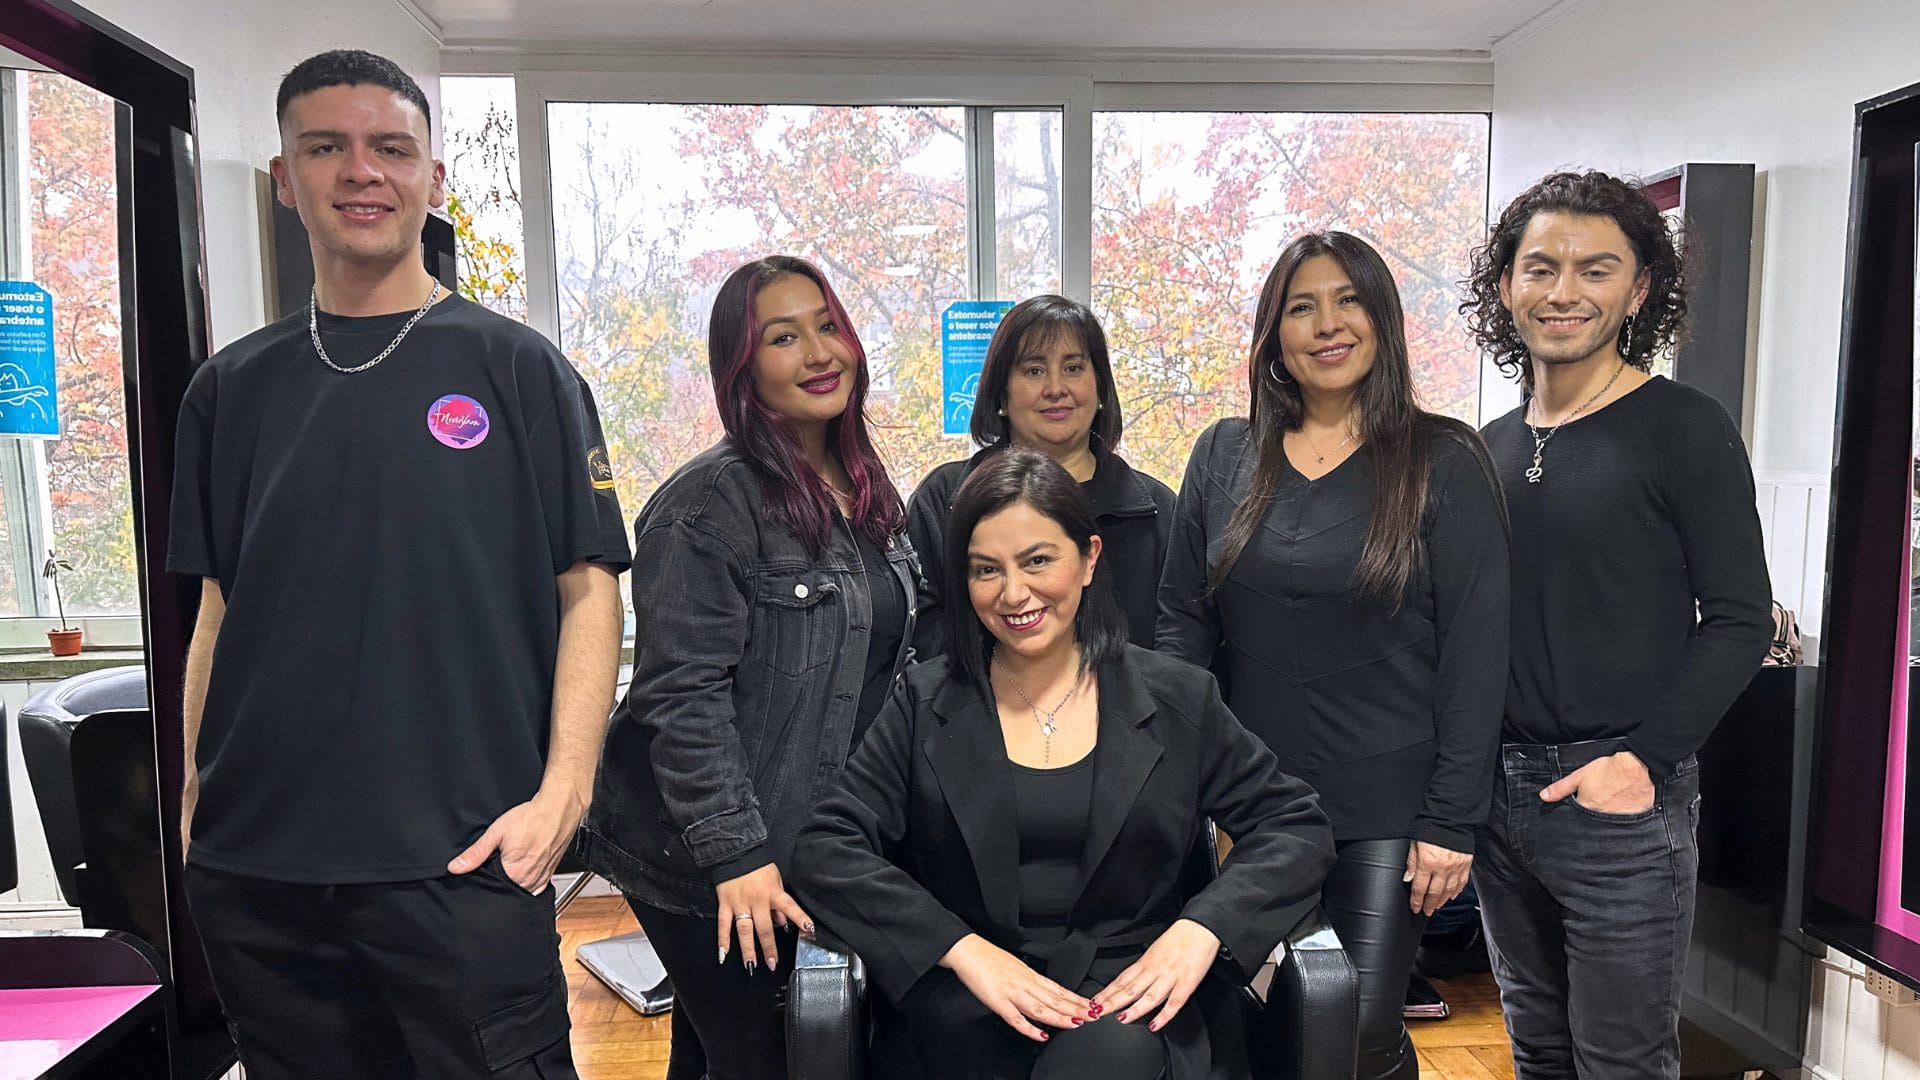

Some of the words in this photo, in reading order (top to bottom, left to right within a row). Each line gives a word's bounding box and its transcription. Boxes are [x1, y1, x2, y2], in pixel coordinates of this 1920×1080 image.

[948, 310, 996, 319] Estornudar
[948, 322, 955, 330] o
[956, 321, 978, 330] toser
[948, 331, 992, 340] antebrazo
